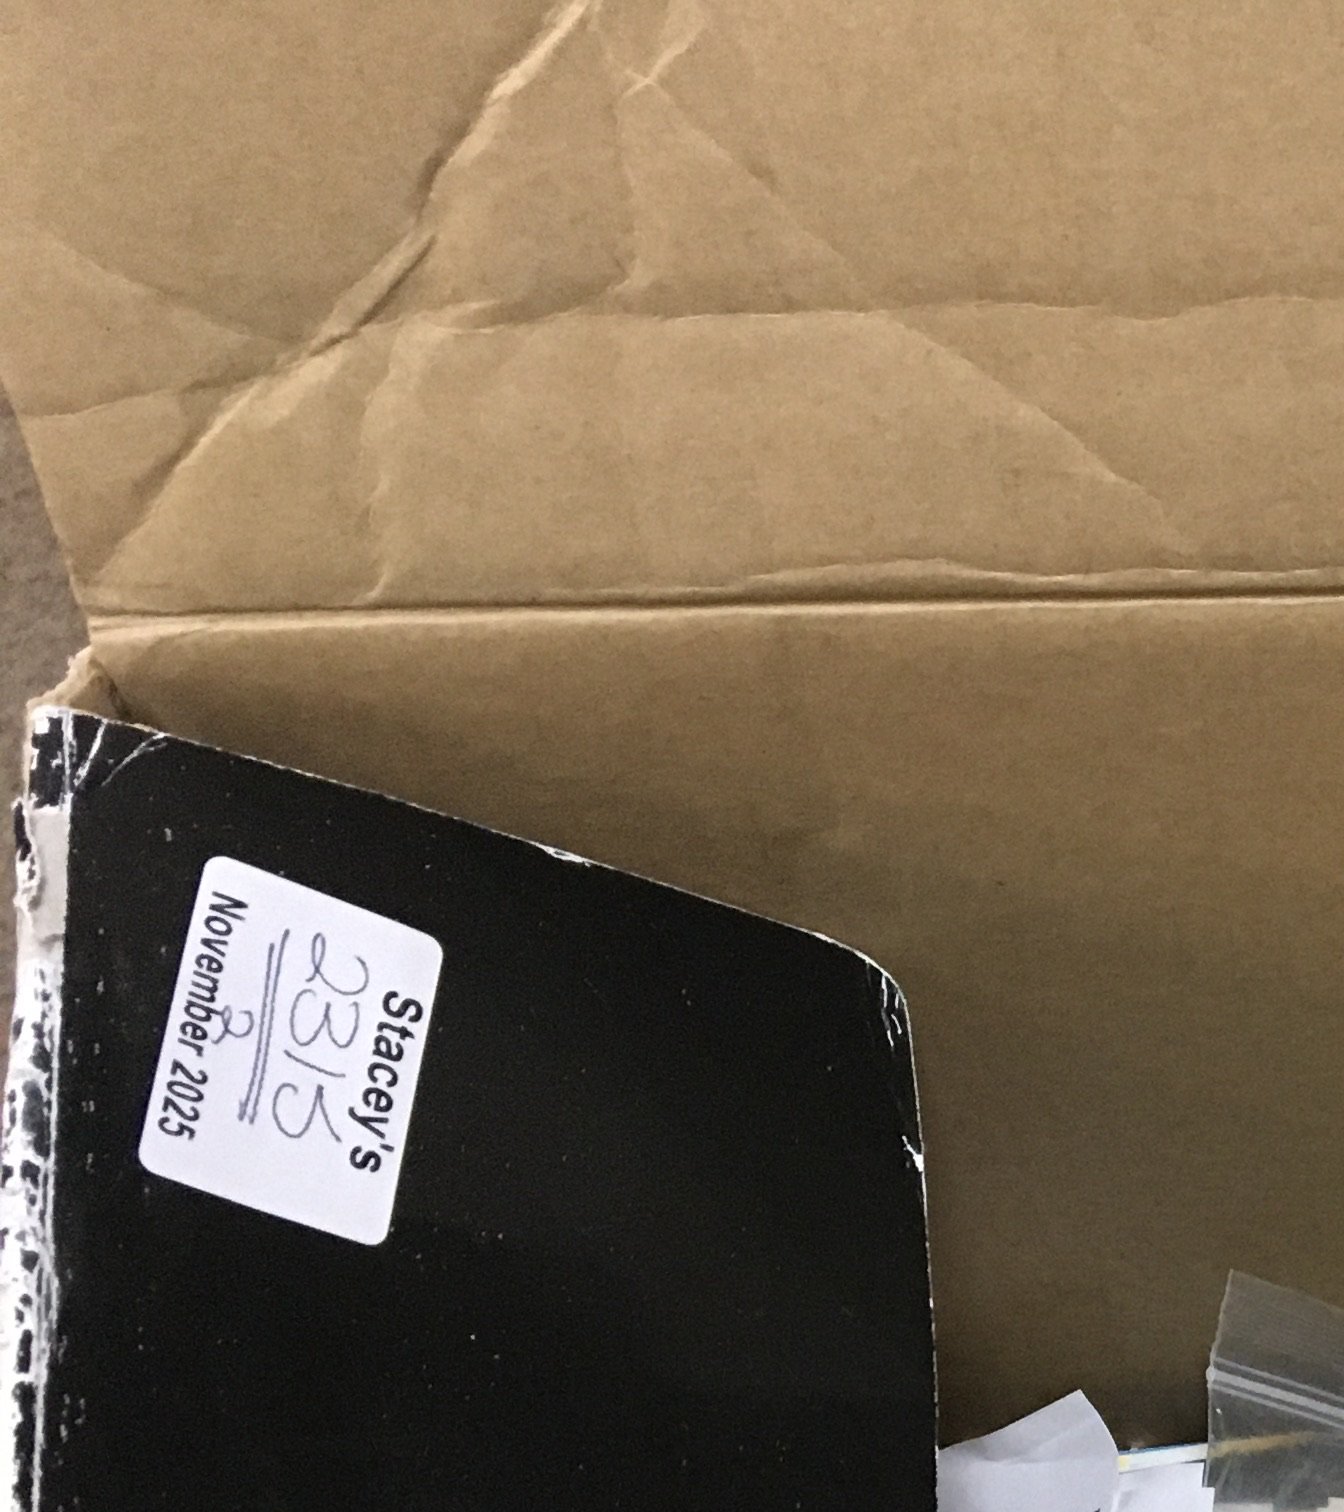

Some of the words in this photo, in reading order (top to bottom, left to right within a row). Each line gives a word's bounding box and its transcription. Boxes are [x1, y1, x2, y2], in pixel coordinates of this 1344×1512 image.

[177, 891, 248, 1057] November
[211, 1005, 255, 1044] 2
[273, 933, 368, 1142] 2315
[158, 1059, 209, 1141] 2025
[349, 991, 423, 1173] Stacey's
